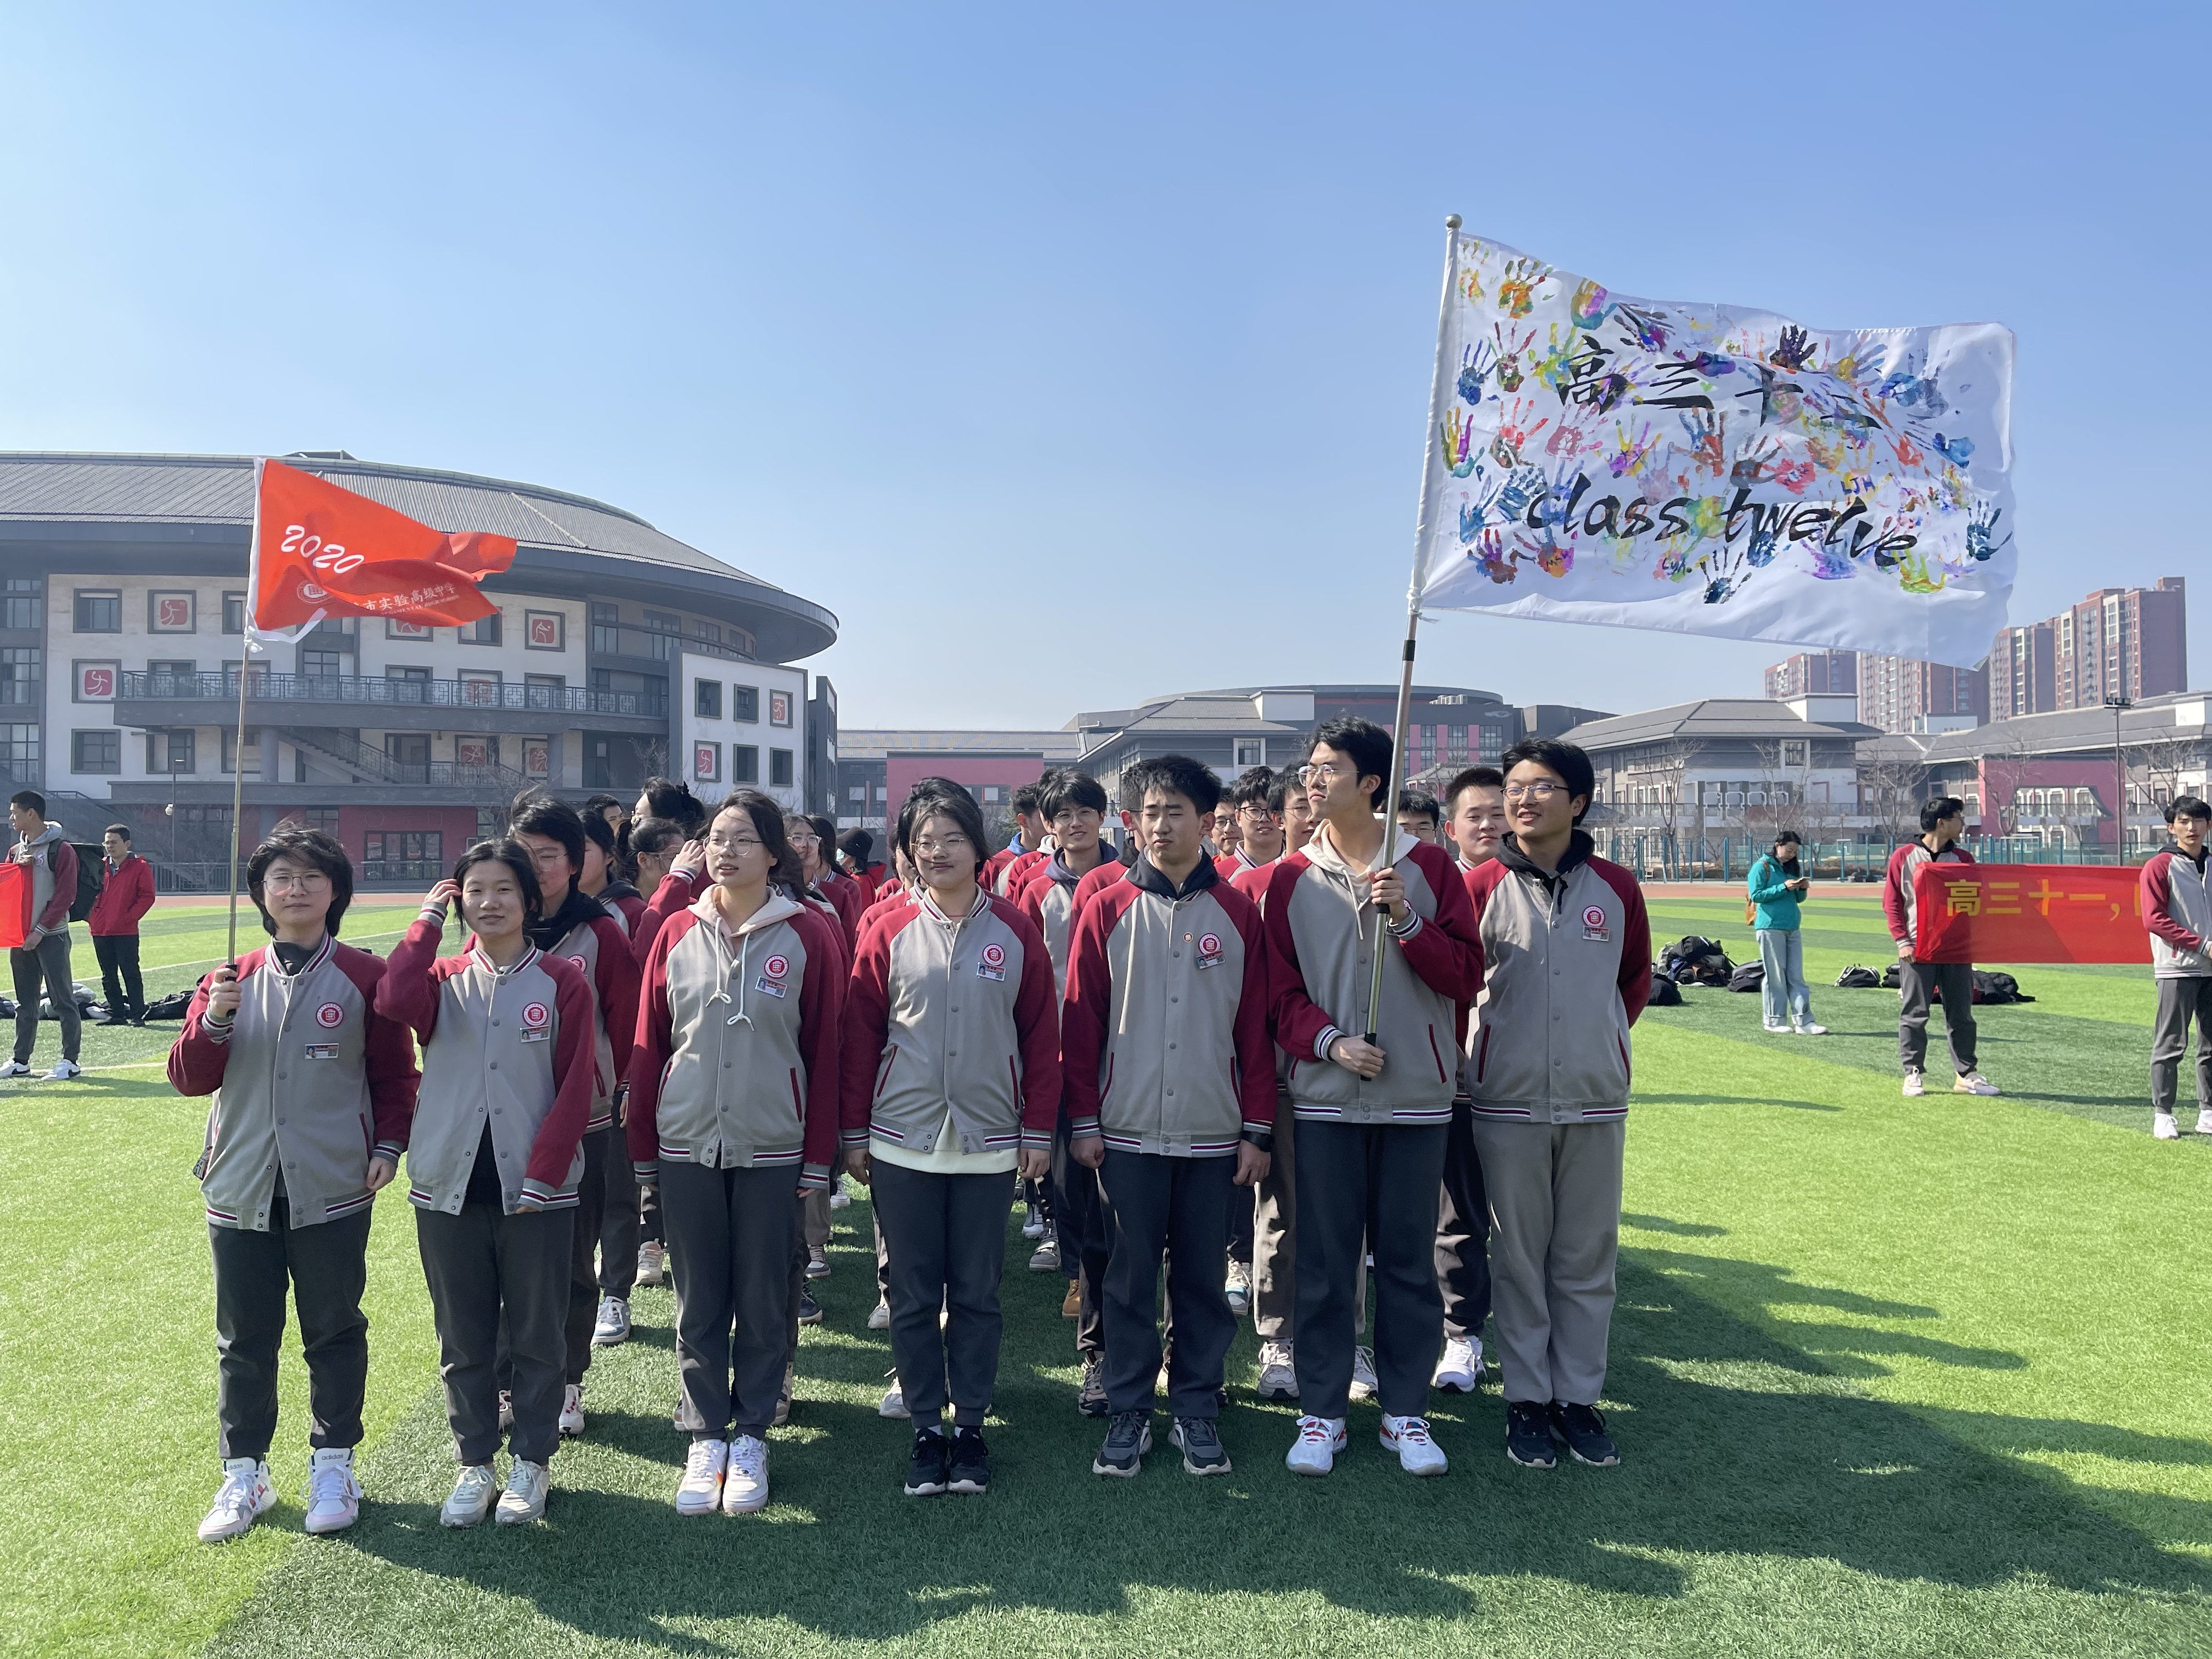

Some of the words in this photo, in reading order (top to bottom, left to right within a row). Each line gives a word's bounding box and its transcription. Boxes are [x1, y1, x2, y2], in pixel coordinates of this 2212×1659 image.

[1555, 334, 1885, 431] 高三十二
[1840, 475, 1877, 496] LJH
[280, 524, 365, 574] 2020
[1714, 487, 1918, 567] twelve
[353, 582, 456, 611] 市实验高级中学
[1944, 878, 2142, 922] 高三十一，
